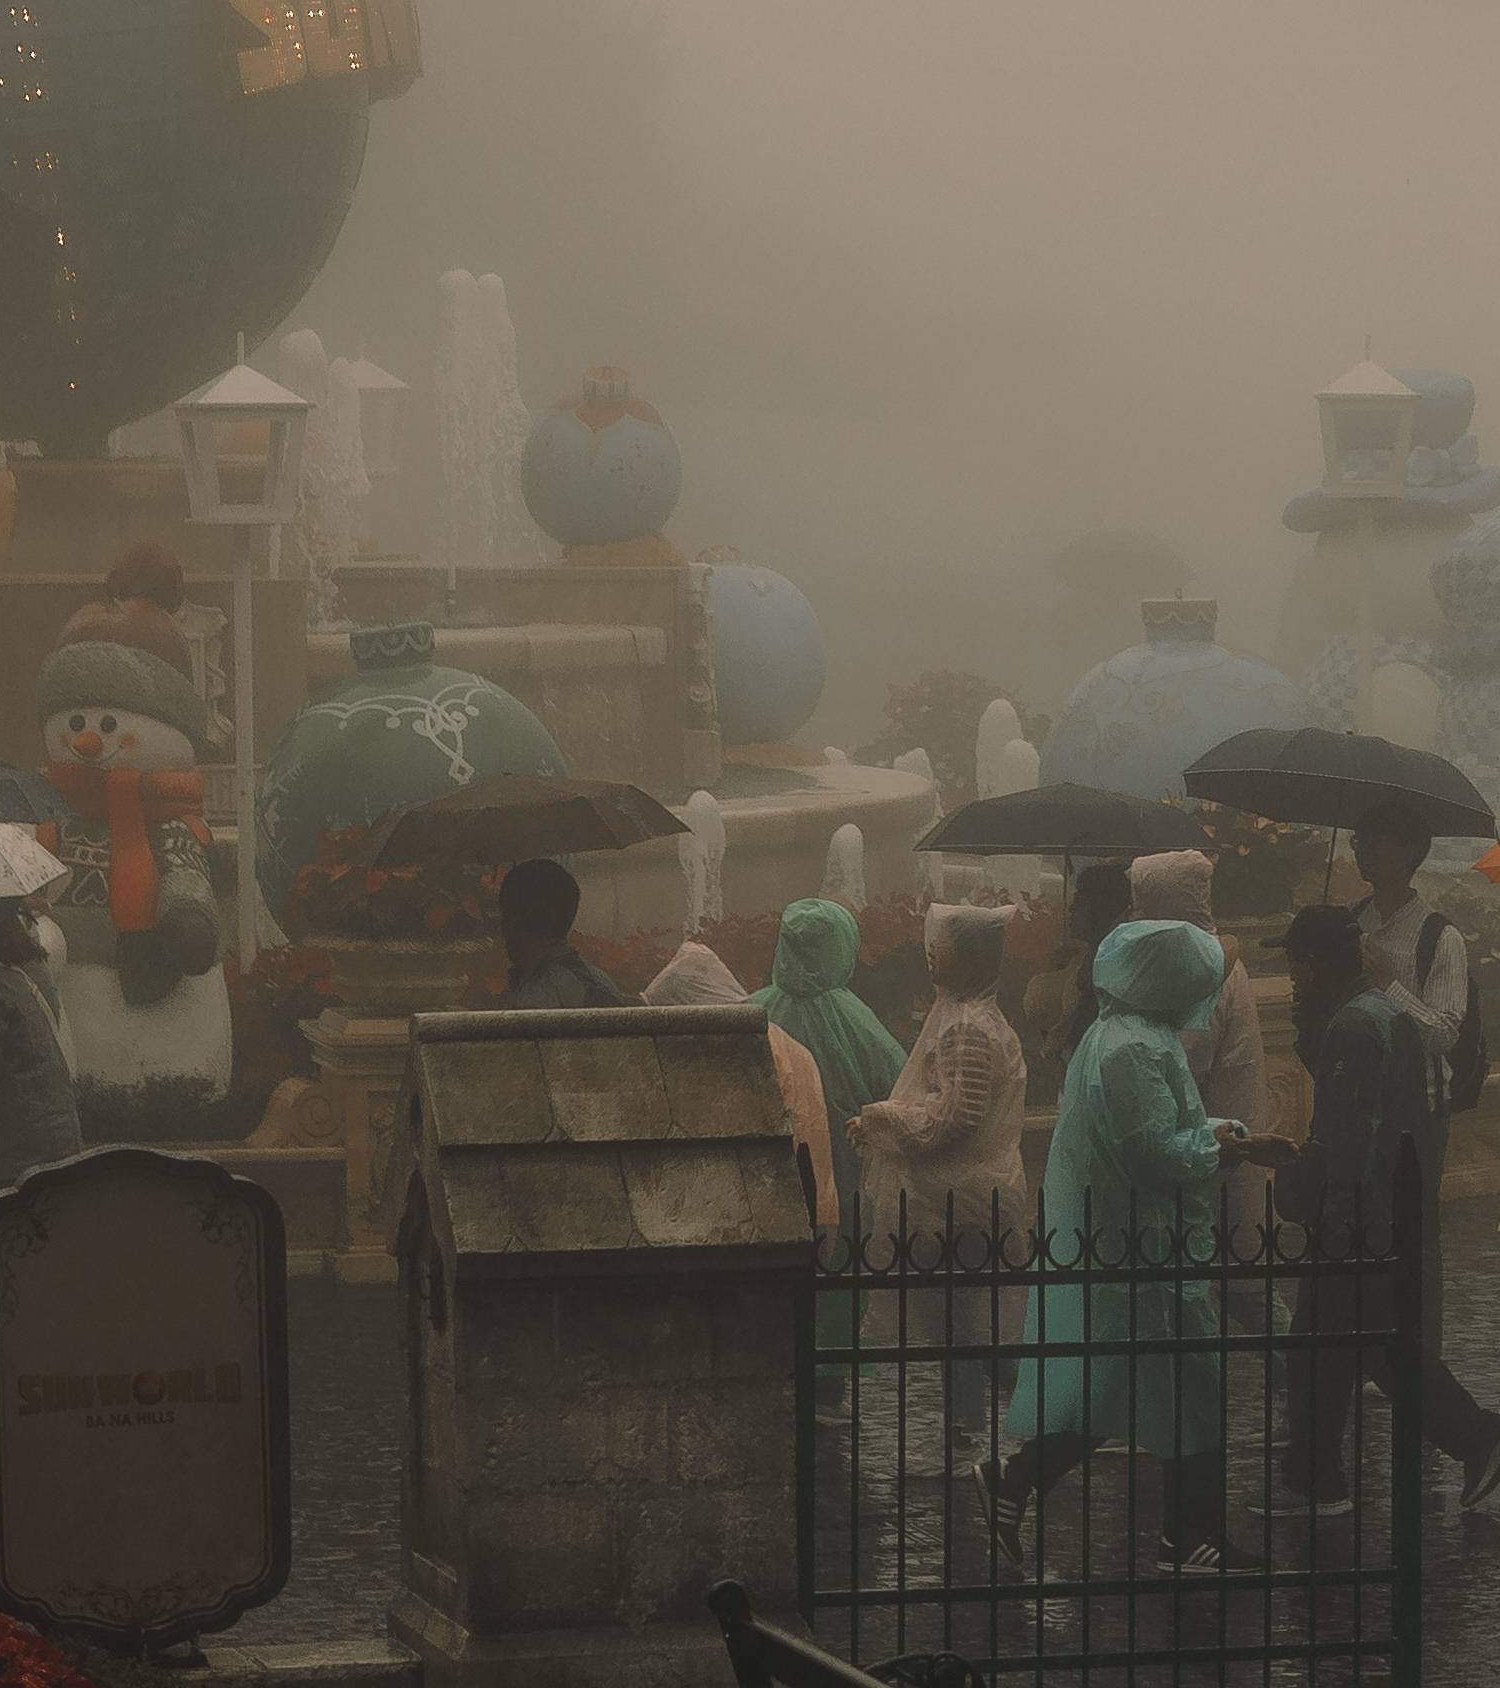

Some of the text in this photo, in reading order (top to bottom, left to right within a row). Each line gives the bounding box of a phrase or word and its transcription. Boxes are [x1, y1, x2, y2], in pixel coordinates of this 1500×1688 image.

[18, 1363, 243, 1416] SUN WORLD
[86, 1411, 175, 1429] BA NA HILLS
